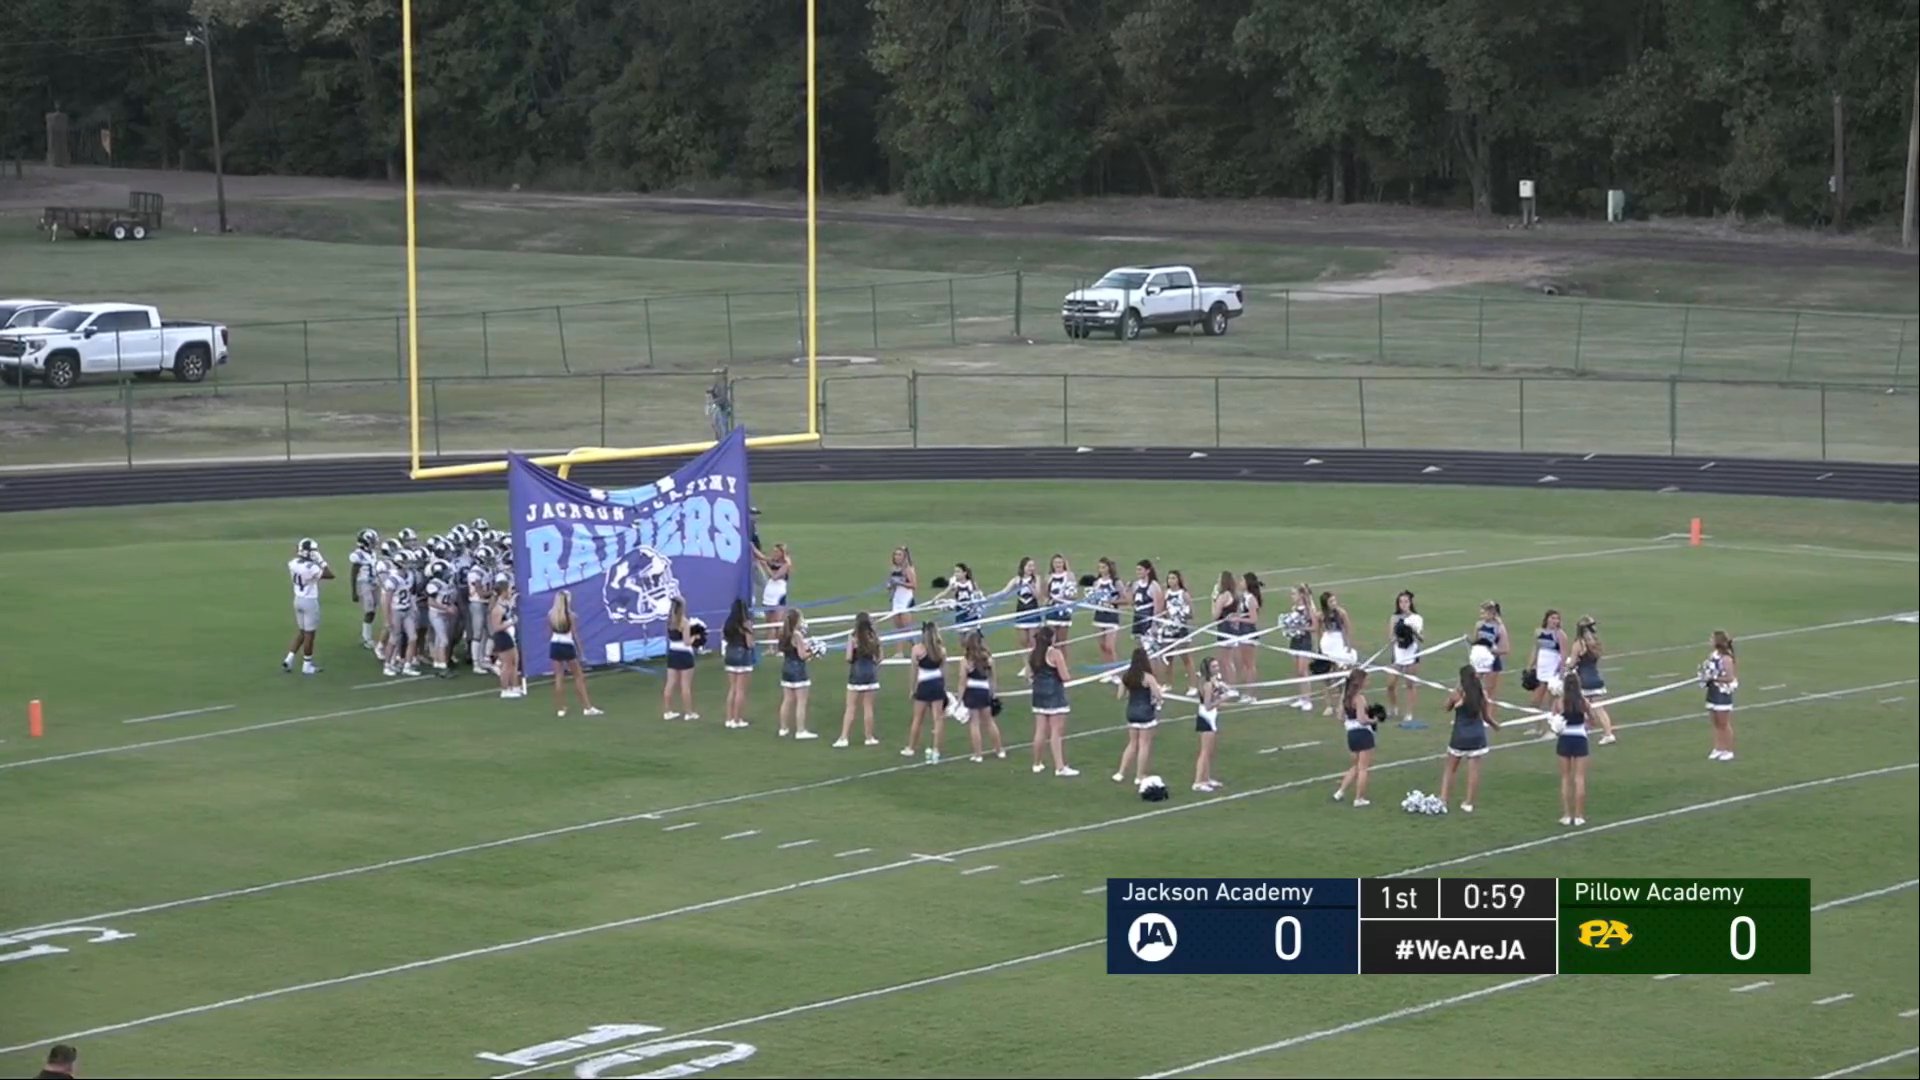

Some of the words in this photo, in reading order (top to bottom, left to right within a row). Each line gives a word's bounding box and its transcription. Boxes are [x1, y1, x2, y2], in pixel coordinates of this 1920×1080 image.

[526, 502, 625, 522] JACKSON
[525, 496, 742, 595] RAIDERS
[475, 1023, 758, 1079] 10
